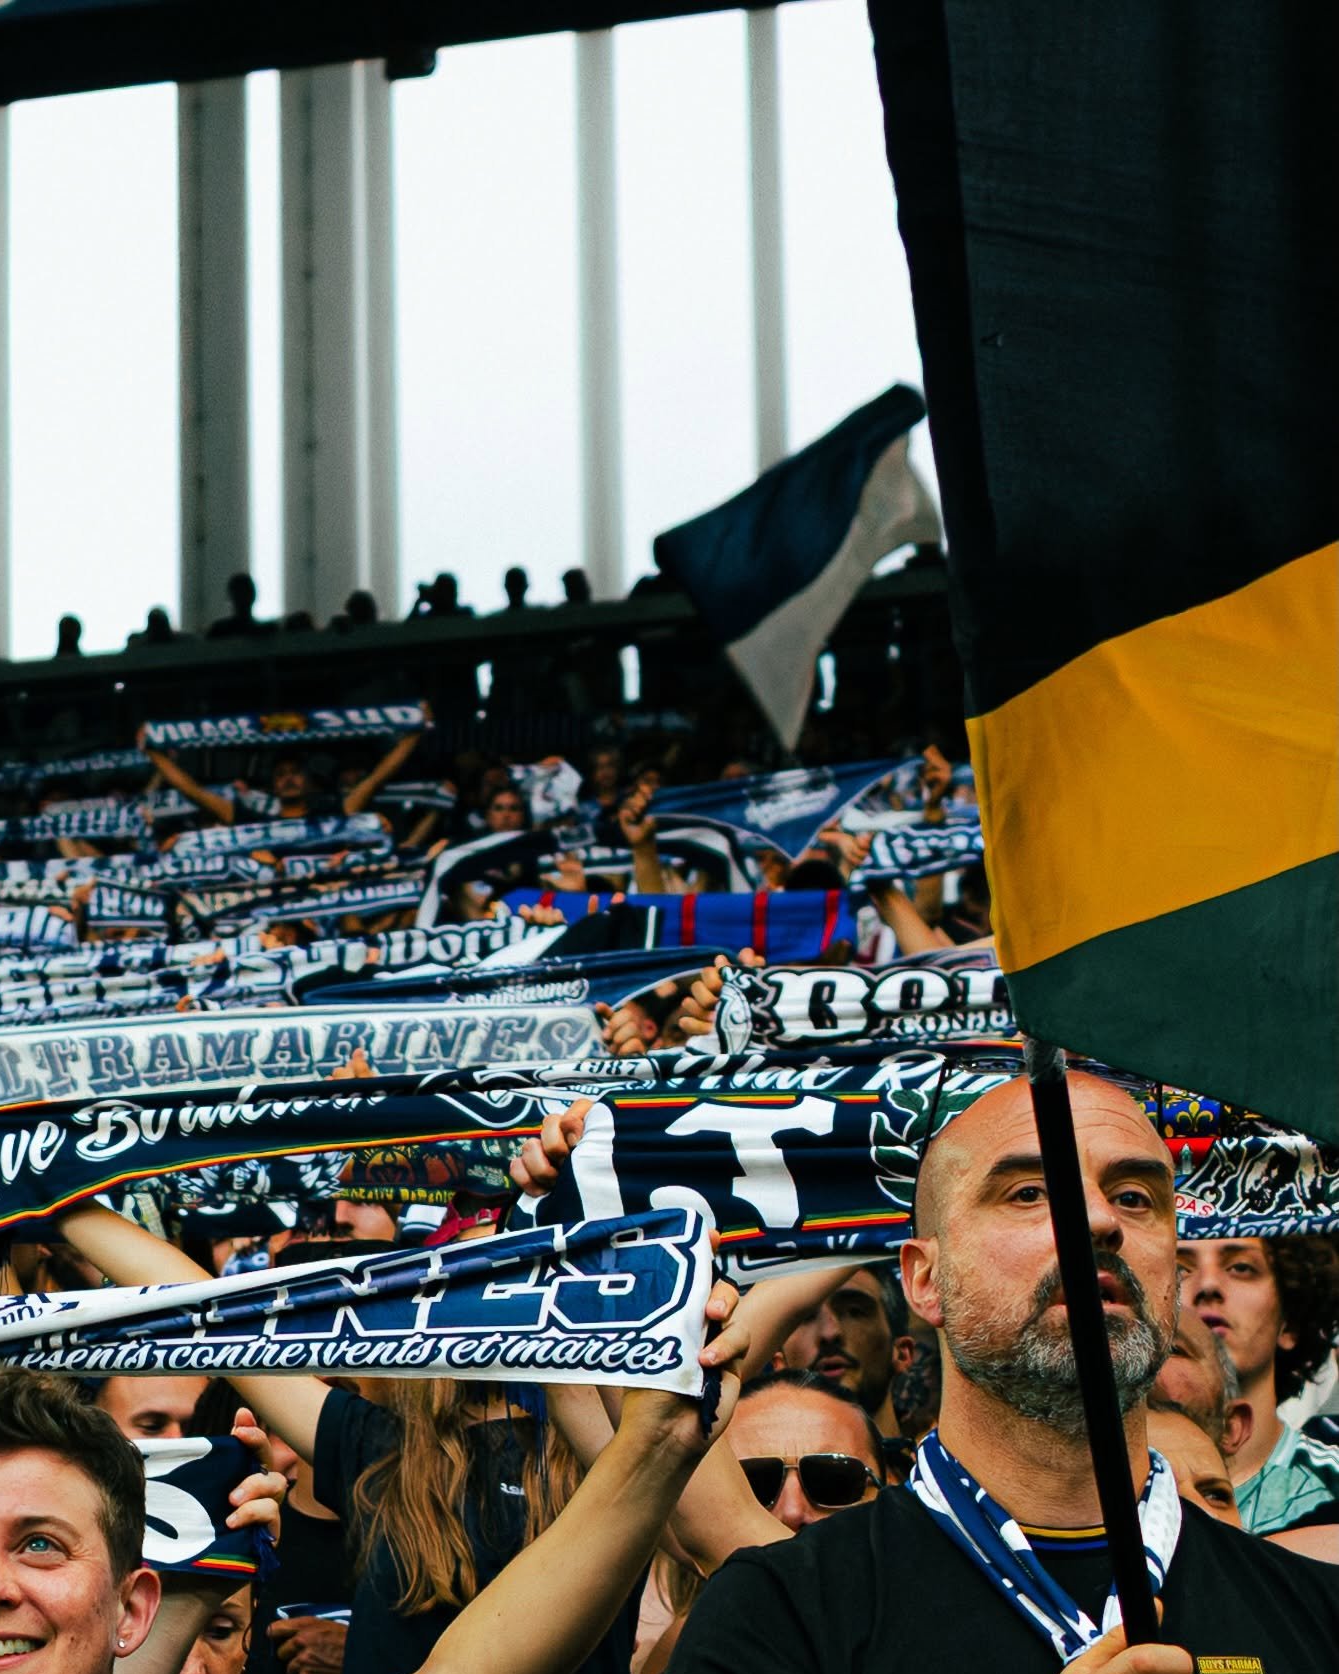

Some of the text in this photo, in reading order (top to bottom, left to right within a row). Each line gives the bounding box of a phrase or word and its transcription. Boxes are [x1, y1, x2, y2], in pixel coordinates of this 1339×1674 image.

[146, 704, 426, 747] VIRAGE SUD
[165, 1336, 310, 1369] contre
[324, 1331, 438, 1368] vents
[455, 1330, 502, 1367] et
[506, 1328, 682, 1371] marées
[1225, 1659, 1261, 1670] PARMA
